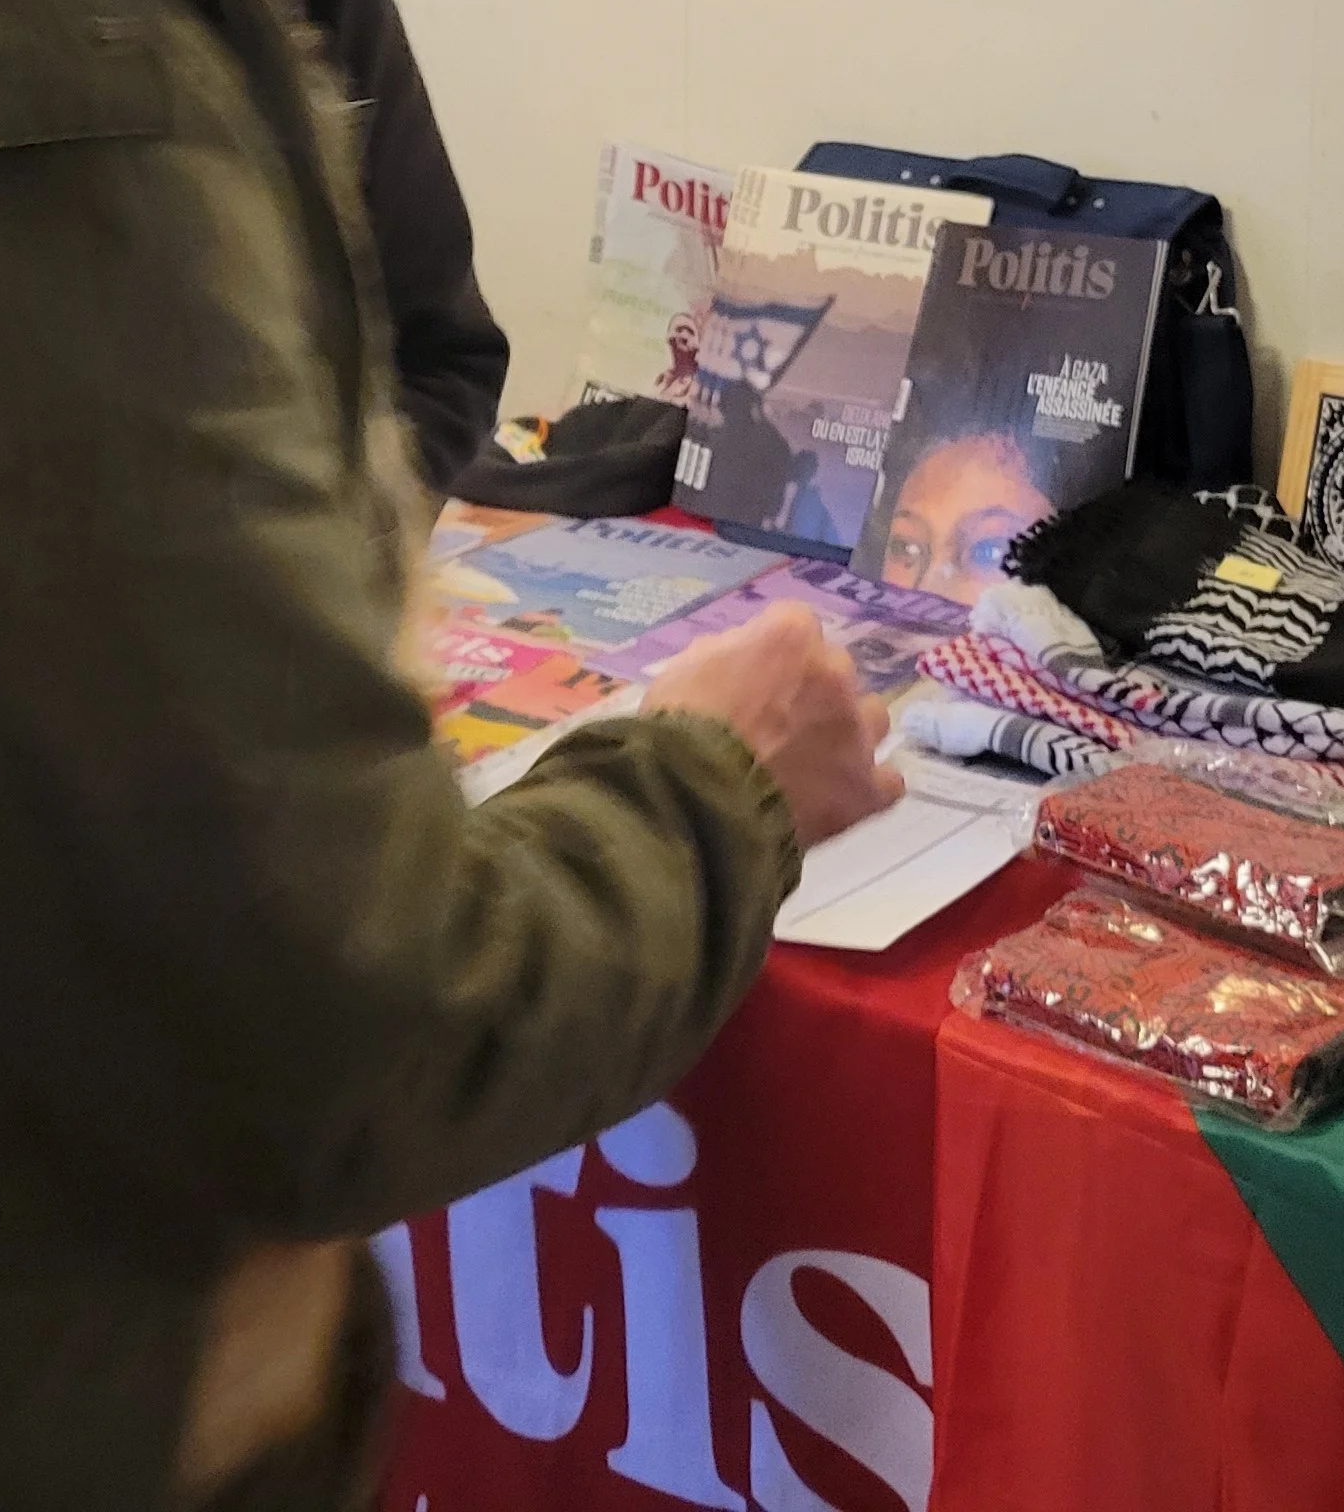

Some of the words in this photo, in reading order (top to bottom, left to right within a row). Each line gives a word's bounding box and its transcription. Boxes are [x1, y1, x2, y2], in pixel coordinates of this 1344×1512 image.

[631, 159, 731, 230] Polit
[957, 237, 1117, 300] Politis
[1071, 359, 1109, 386] GAZA
[1036, 396, 1124, 428] ASSASSINÉE
